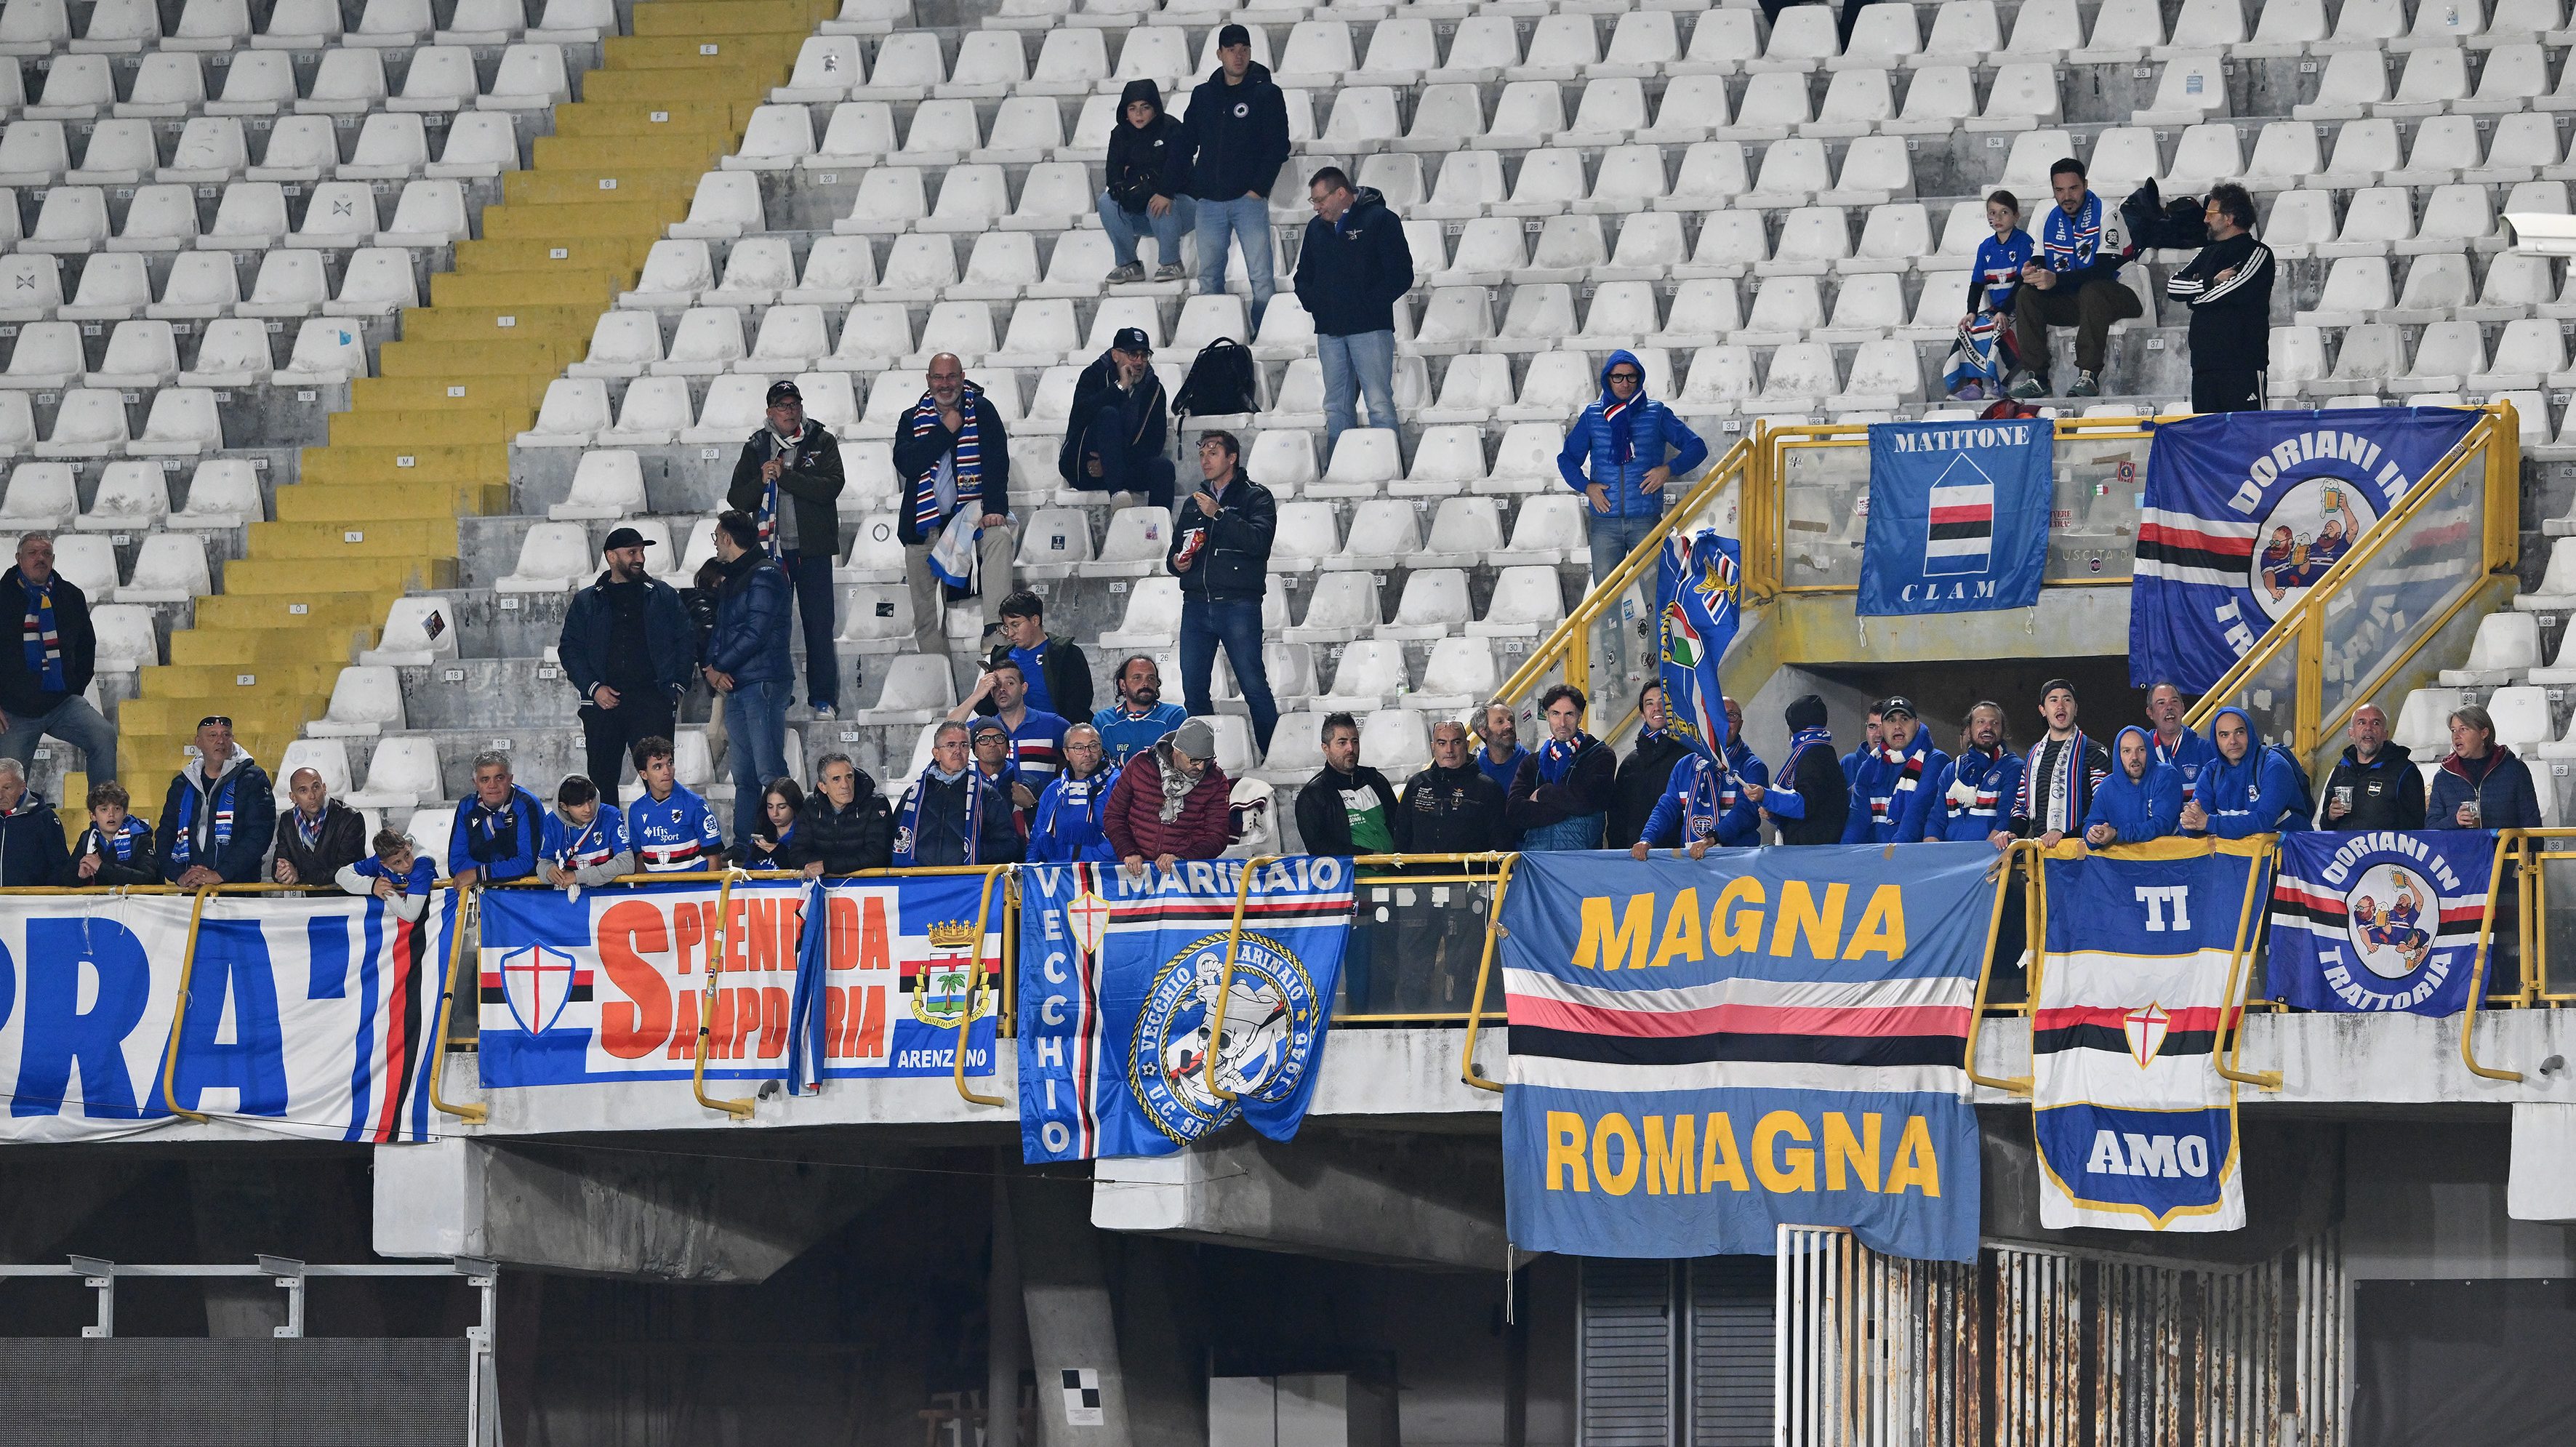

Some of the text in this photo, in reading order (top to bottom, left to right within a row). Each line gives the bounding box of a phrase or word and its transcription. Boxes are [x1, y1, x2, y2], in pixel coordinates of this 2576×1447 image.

[1893, 425, 2030, 454] MATITONE
[2228, 430, 2382, 516] DORIANI
[1901, 580, 1997, 603] CLAM
[652, 826, 668, 835] Ifis
[660, 833, 679, 843] sport
[2322, 831, 2461, 891] DORIANI IN
[1570, 875, 1908, 972] MAGNA
[2135, 885, 2192, 932] TI
[2318, 945, 2453, 1011] TRATTORIA
[0, 914, 350, 1119] RA'
[1035, 866, 1070, 1154] VECCHIO
[1140, 966, 1191, 1053] VECCHIO
[897, 1048, 987, 1069] ARENZNO
[1280, 1032, 1309, 1088] 1946
[1546, 1110, 1941, 1199] ROMAGNA
[2086, 1129, 2209, 1179] AMO
